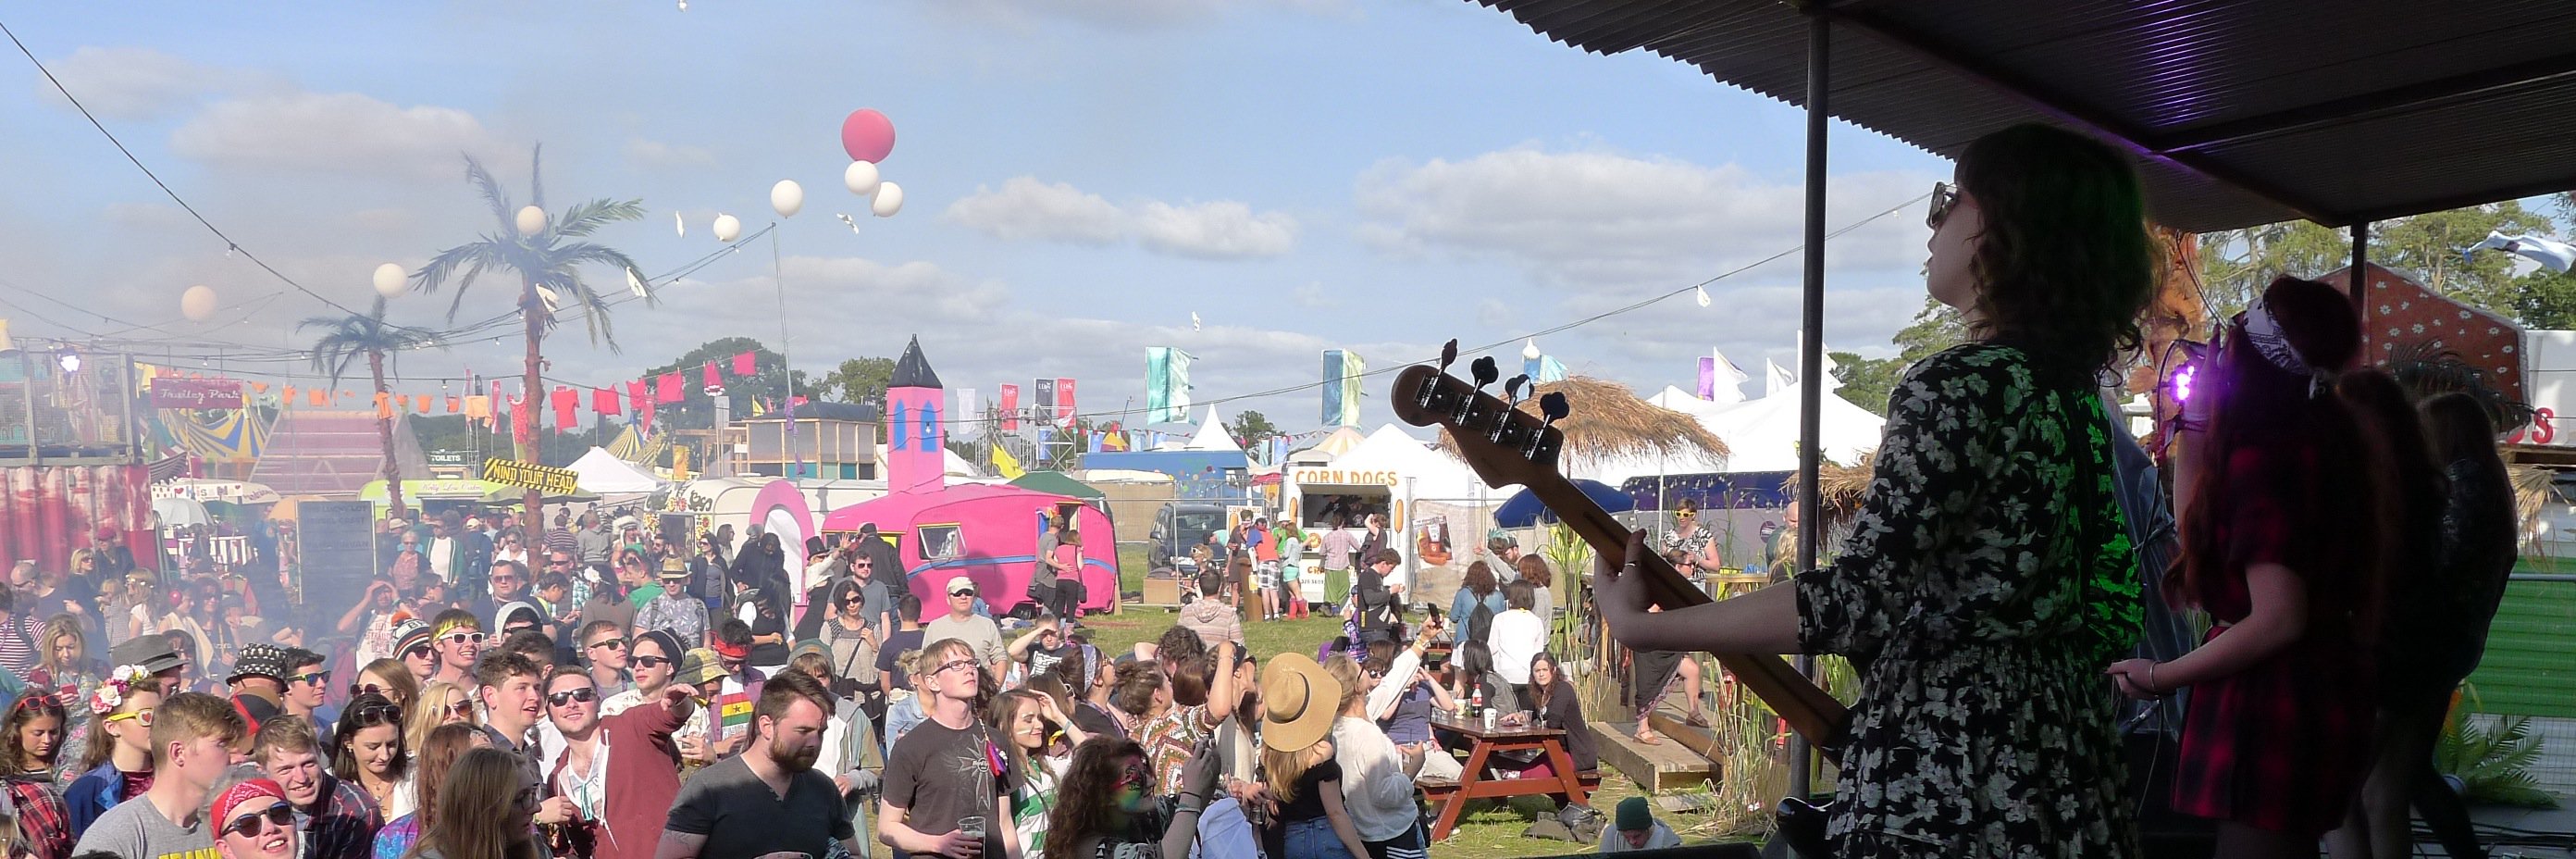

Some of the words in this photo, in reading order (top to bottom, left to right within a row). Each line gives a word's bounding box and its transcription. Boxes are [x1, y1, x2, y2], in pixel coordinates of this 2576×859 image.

[208, 389, 241, 399] Park
[493, 465, 517, 481] MIND
[519, 467, 544, 486] YOUR
[546, 472, 573, 490] HEAD
[1295, 470, 1344, 484] CORN
[1350, 470, 1398, 487] DOGS
